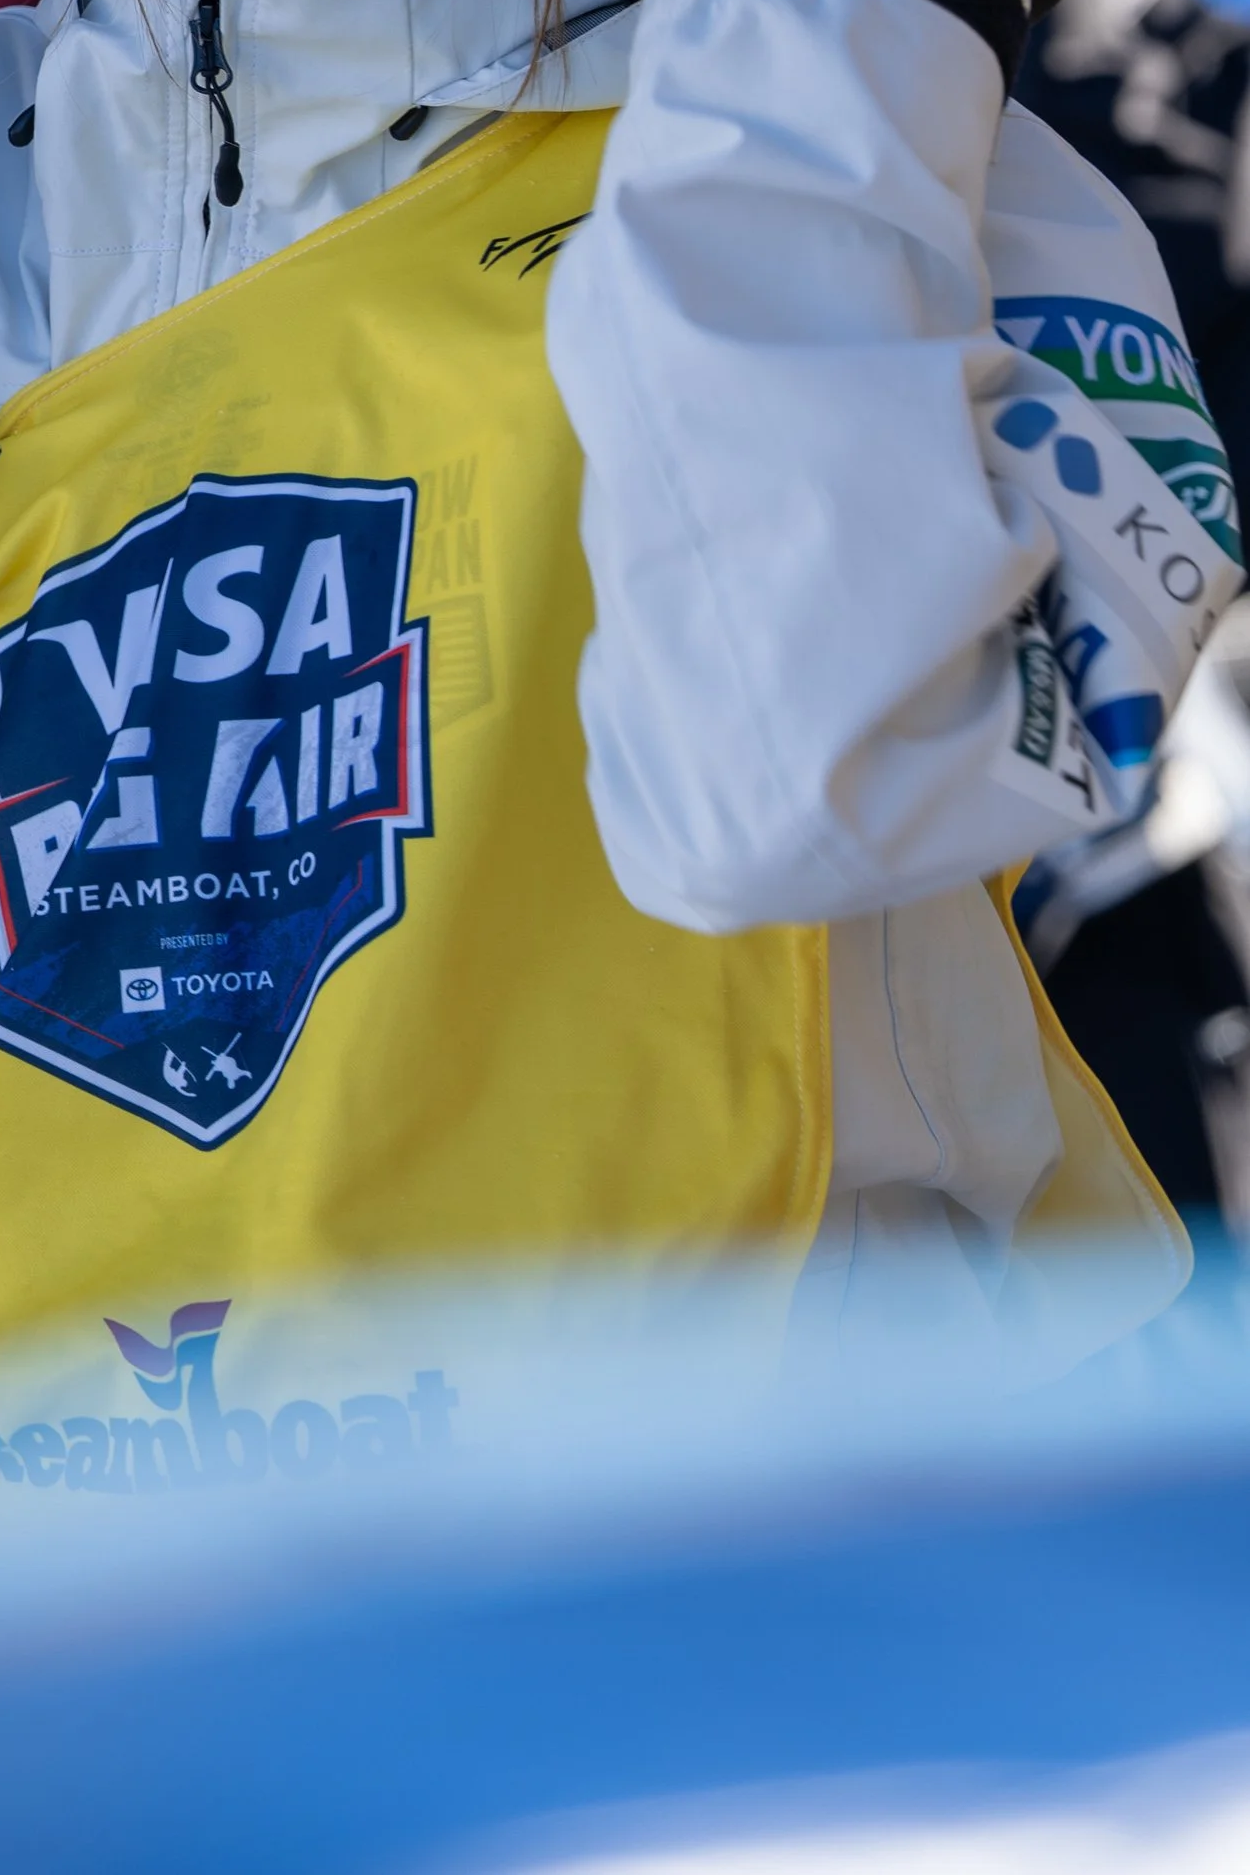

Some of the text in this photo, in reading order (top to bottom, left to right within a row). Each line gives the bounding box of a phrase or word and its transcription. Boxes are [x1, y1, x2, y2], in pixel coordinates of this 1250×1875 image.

[1064, 314, 1206, 409] YON
[288, 851, 317, 886] CO
[160, 932, 229, 950] PRESENTED BY
[171, 970, 274, 996] TOYOTA
